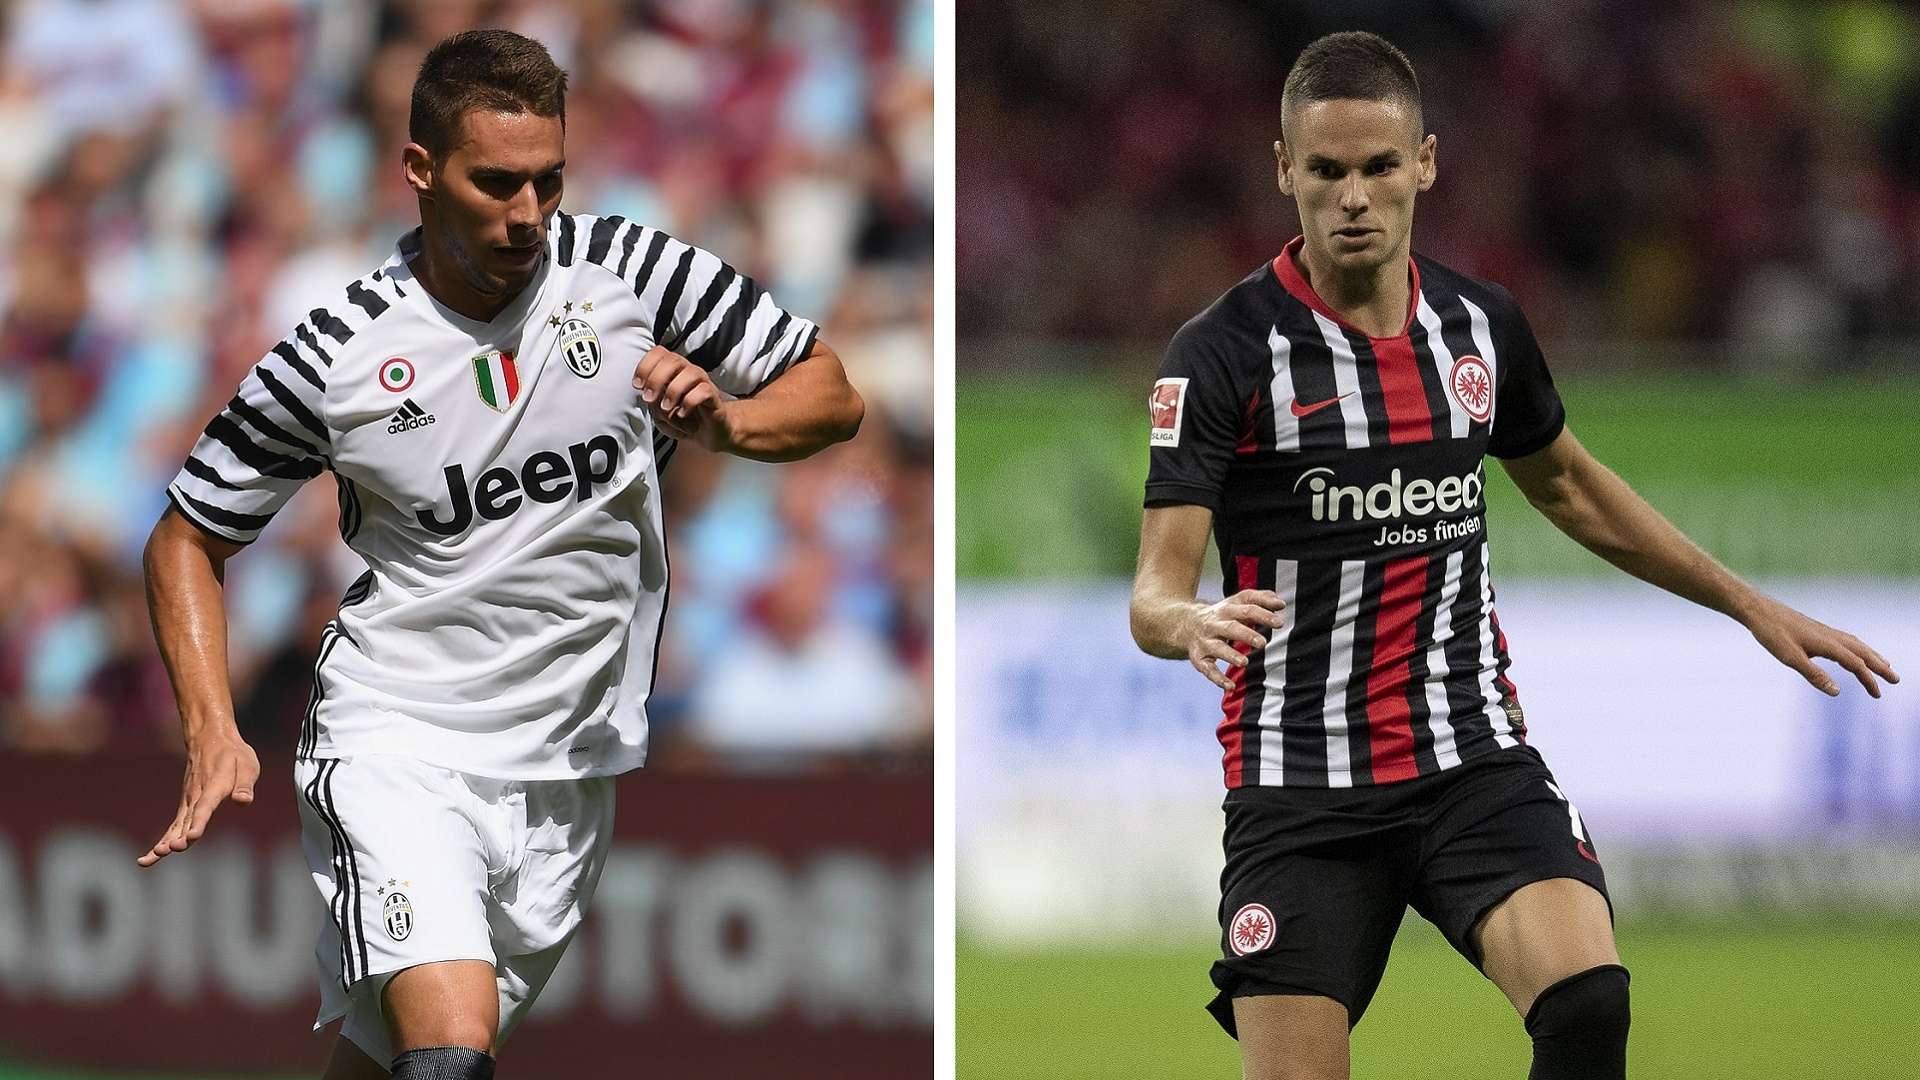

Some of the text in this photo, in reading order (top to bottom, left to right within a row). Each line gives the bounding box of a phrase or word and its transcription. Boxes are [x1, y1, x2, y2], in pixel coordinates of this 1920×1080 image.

[388, 414, 436, 434] adidas
[415, 434, 619, 536] Jeep
[1307, 459, 1483, 521] indeed
[1373, 514, 1481, 546] Jobs finden
